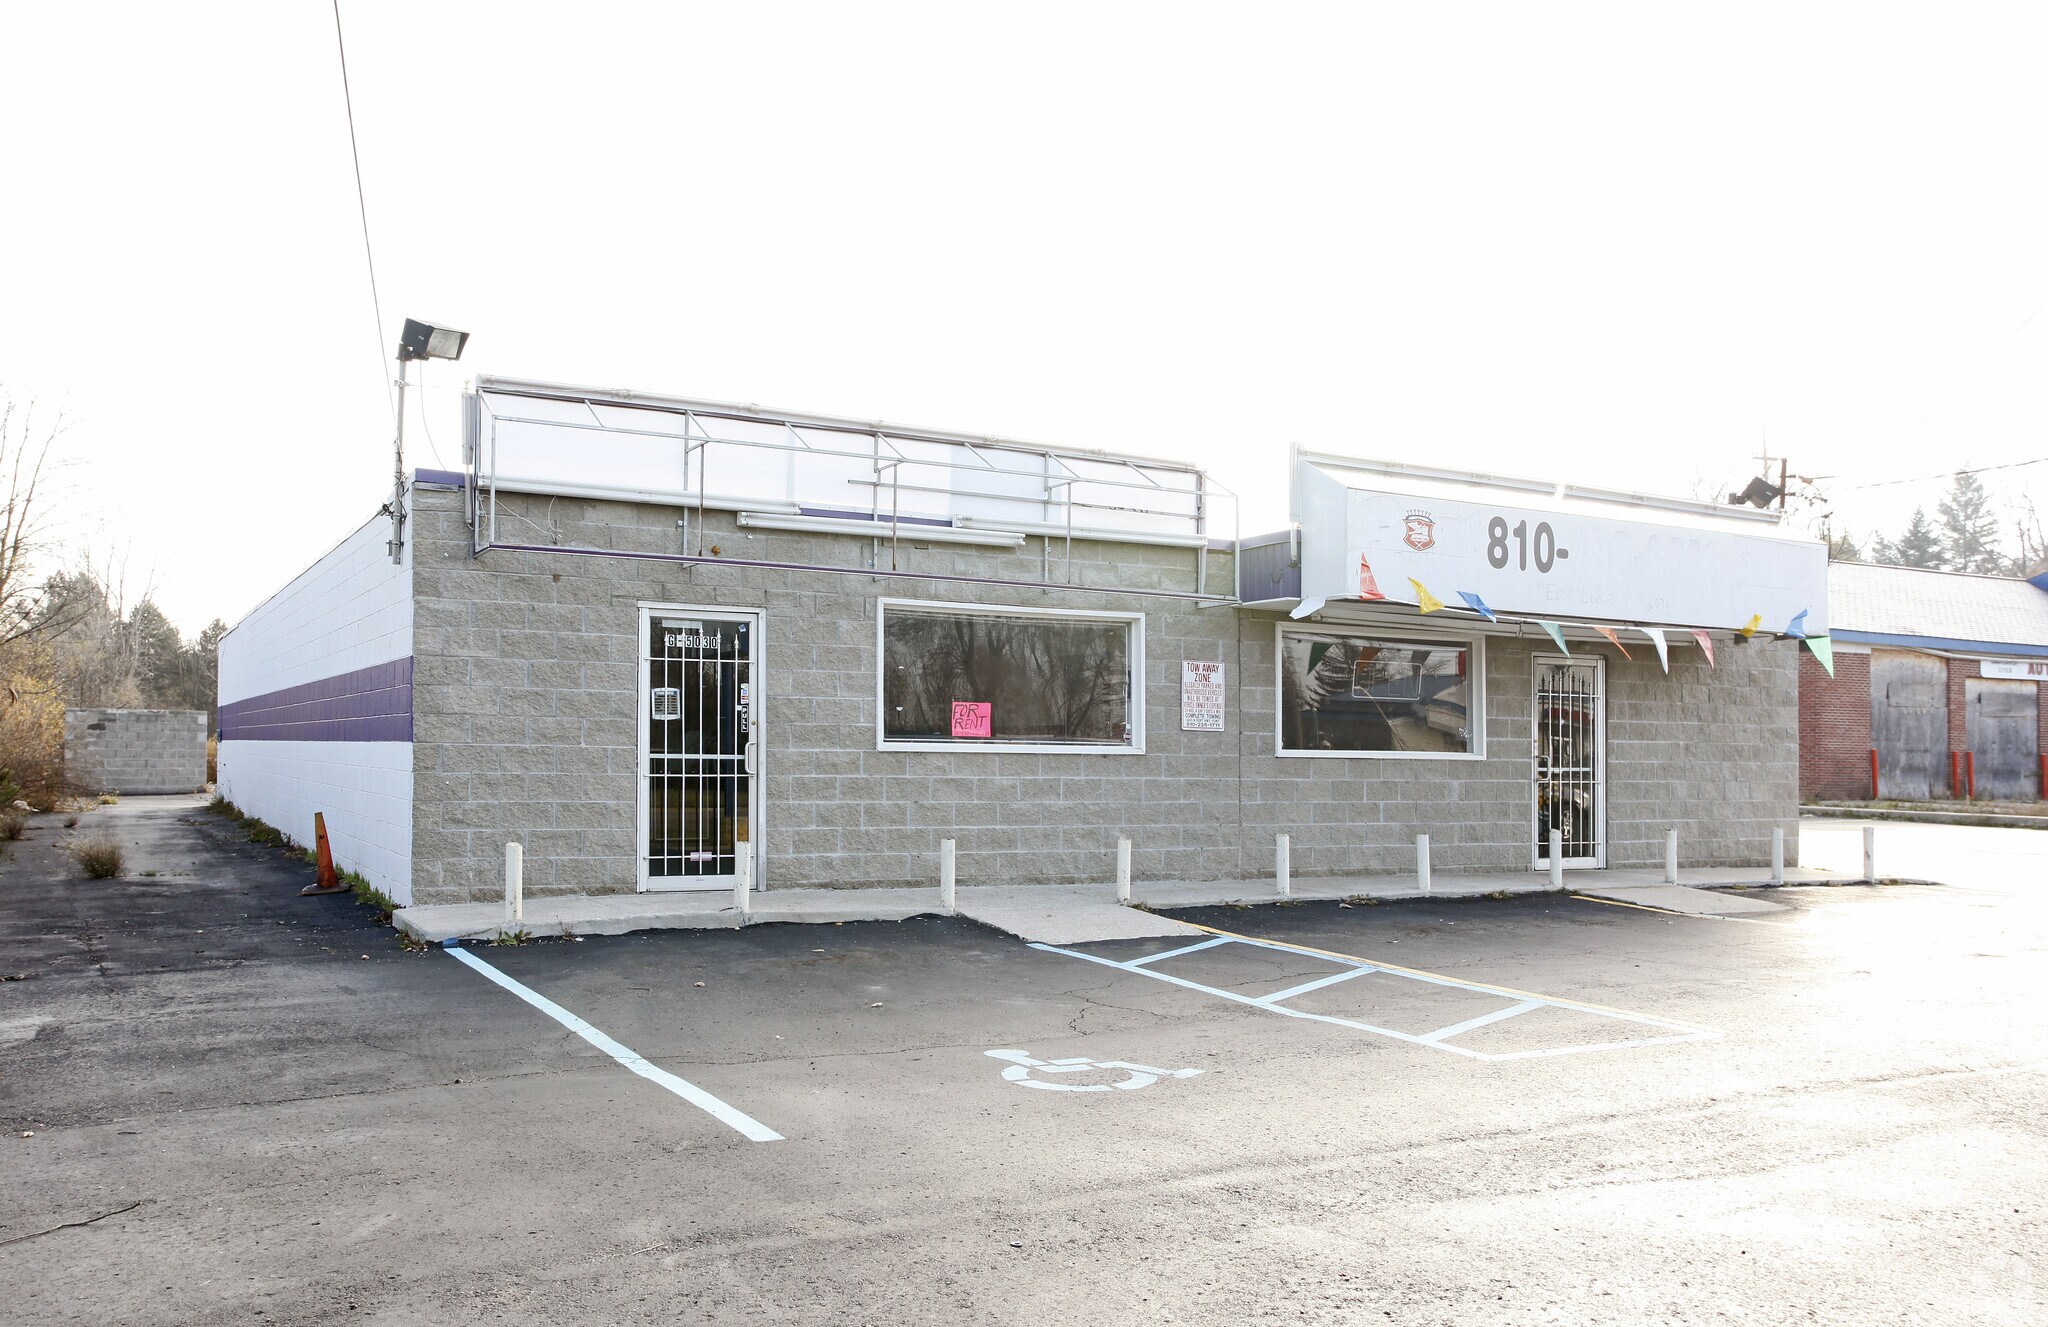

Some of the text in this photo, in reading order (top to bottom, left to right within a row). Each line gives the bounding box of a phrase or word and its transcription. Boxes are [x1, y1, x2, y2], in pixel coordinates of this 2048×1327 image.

[1487, 516, 1569, 573] 810-
[668, 635, 717, 648] G-5030
[1187, 663, 1219, 673] TOW AWAY
[1194, 673, 1211, 682] ZONE
[1201, 682, 1214, 690] PARKED
[953, 704, 979, 720] FOR
[954, 716, 987, 730] RENT
